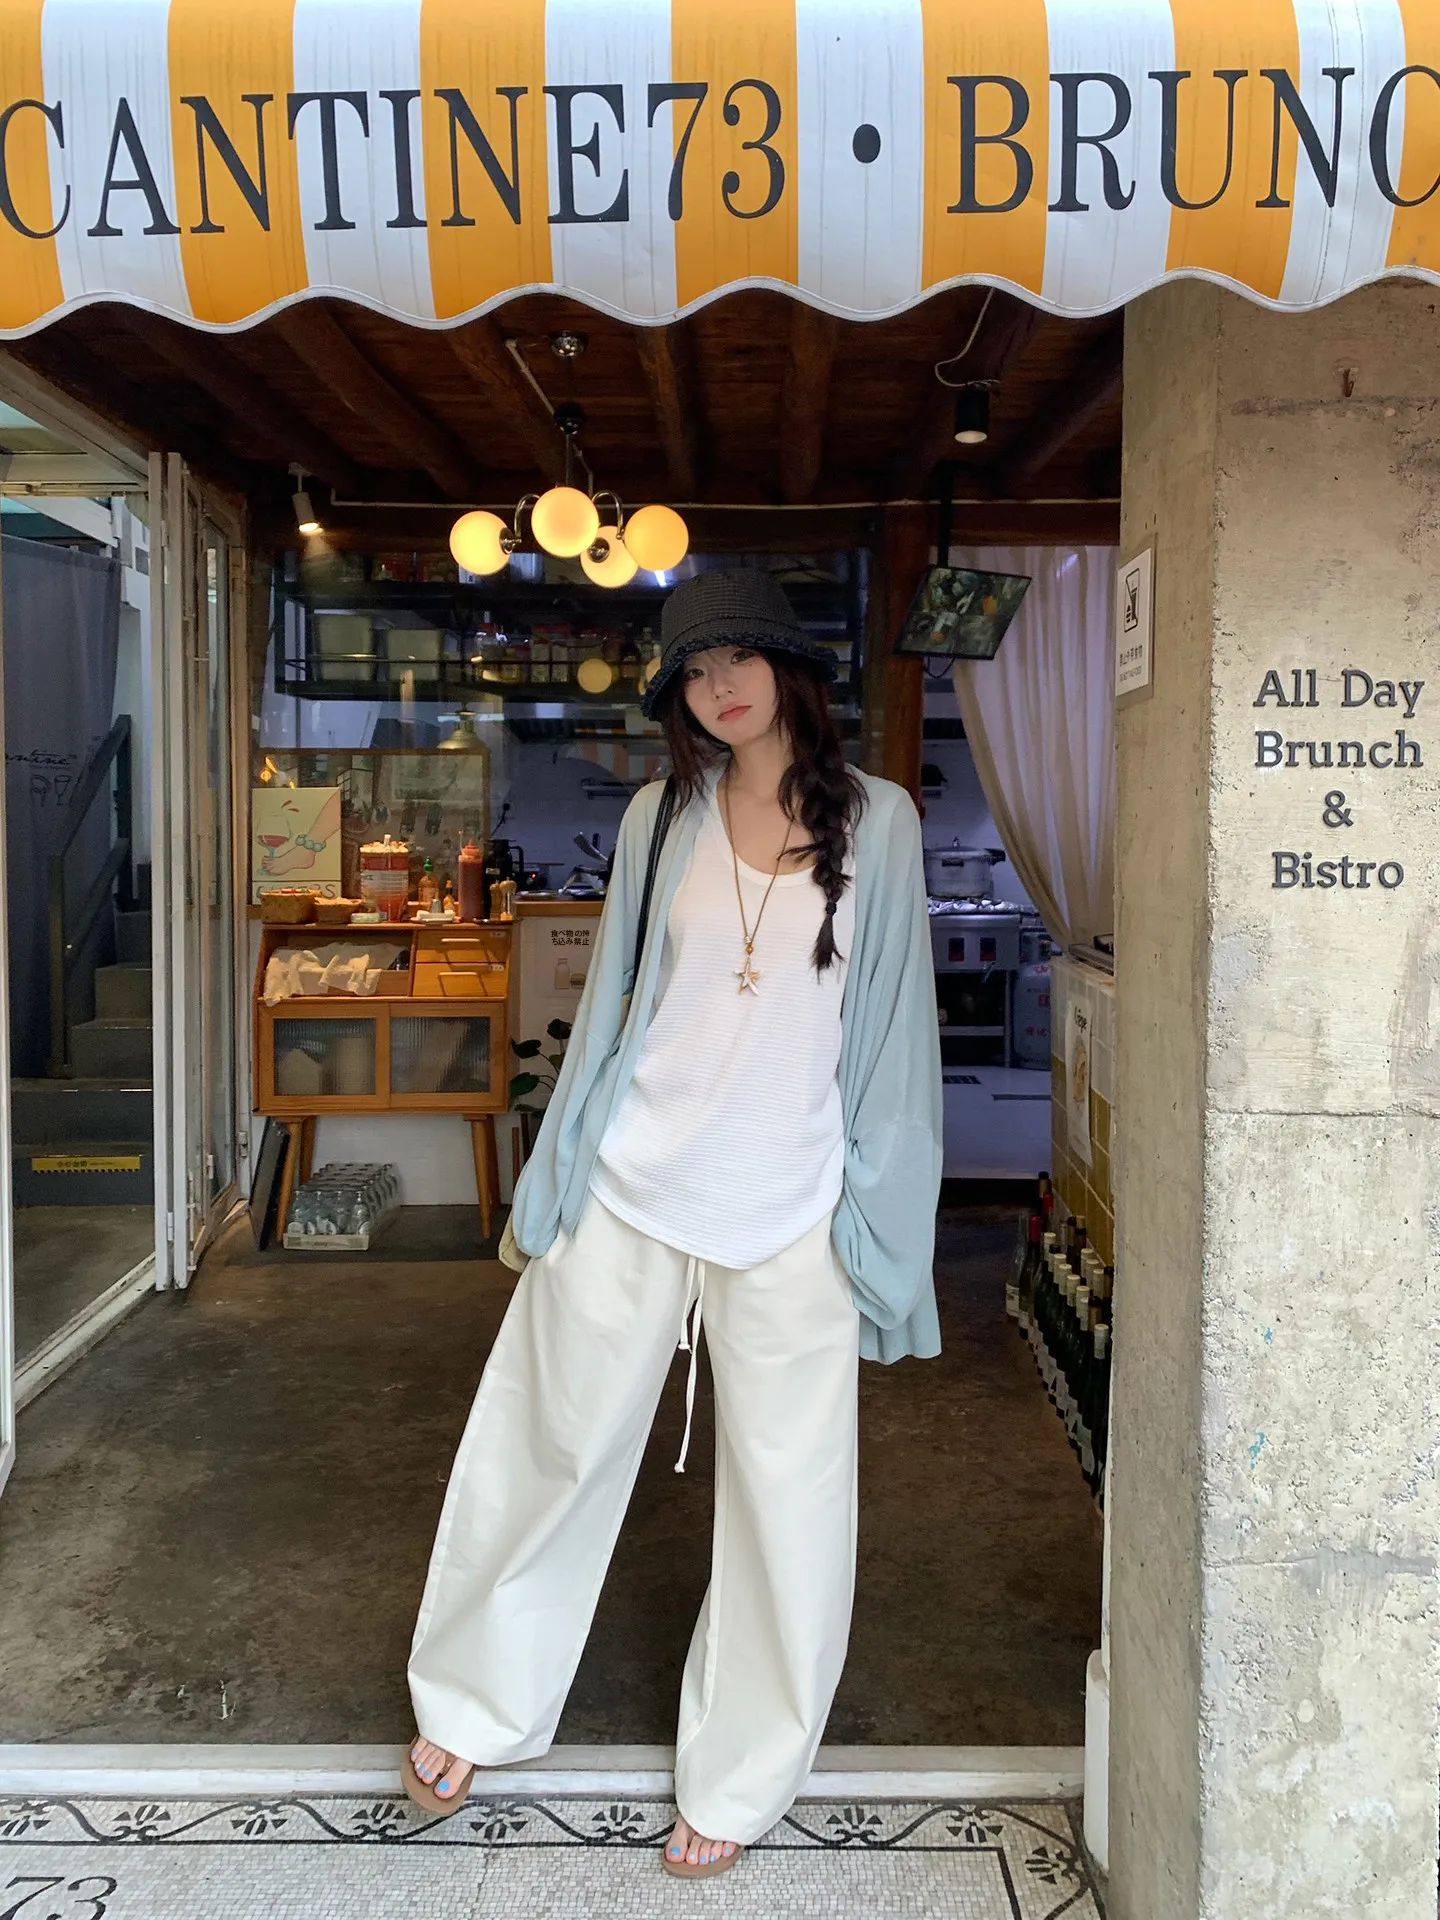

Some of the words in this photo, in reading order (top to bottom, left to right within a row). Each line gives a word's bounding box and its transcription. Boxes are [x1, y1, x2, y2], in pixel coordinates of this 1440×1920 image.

[0, 79, 785, 239] CANTINE73
[1253, 669, 1319, 707] All
[1341, 669, 1424, 718] Day
[1254, 730, 1423, 768] Brunch
[1322, 790, 1353, 827] &
[1271, 851, 1404, 888] Bistro
[0, 1876, 117, 1920] 73
